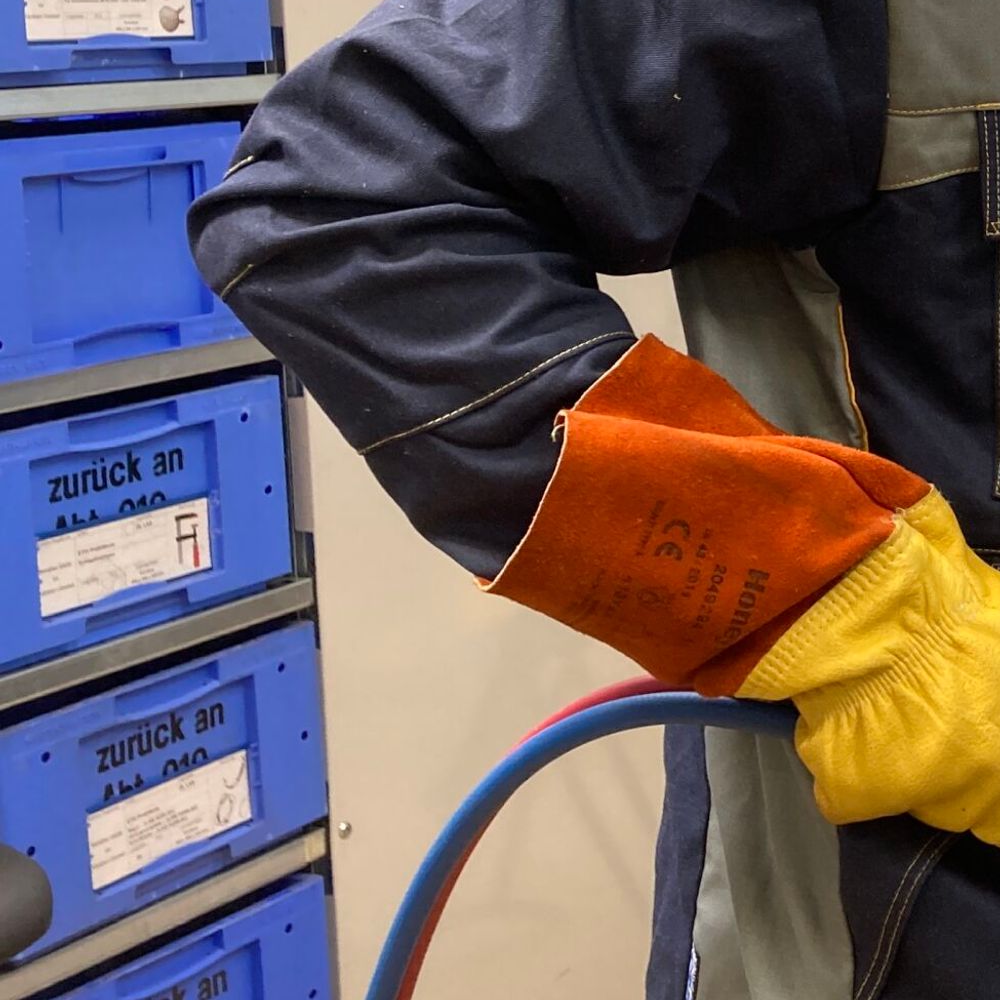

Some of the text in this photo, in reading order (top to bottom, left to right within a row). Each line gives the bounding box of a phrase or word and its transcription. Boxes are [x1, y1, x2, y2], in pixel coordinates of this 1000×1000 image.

[47, 450, 143, 504] zurück
[153, 447, 184, 478] an
[653, 518, 691, 562] CE
[96, 712, 186, 774] zurück
[194, 702, 225, 735] an
[198, 970, 228, 1000] an
